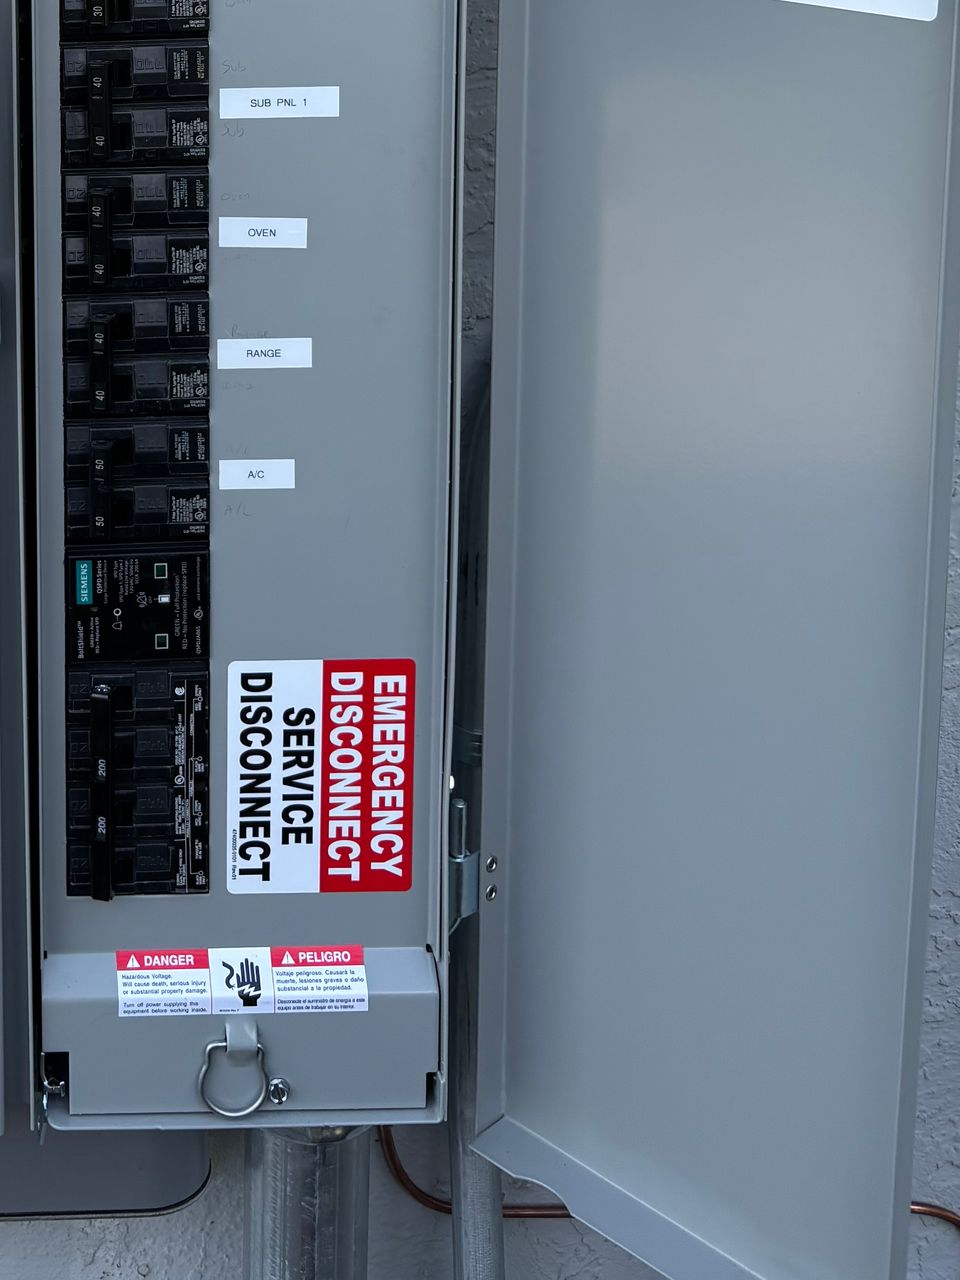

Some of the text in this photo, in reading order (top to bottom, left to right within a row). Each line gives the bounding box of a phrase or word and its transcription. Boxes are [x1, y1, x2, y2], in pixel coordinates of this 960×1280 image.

[94, 6, 102, 17] 30
[93, 77, 102, 88] 40
[250, 98, 271, 108] SUB
[277, 98, 296, 107] PNL
[96, 136, 104, 147] 40
[93, 206, 101, 217] 40
[248, 228, 276, 237] OVEN
[95, 264, 104, 275] 40
[95, 333, 104, 344] 40
[246, 349, 281, 359] RANGE
[96, 391, 105, 402] 40
[96, 459, 103, 471] 50
[248, 470, 264, 480] A/C
[96, 516, 104, 527] 50
[98, 759, 106, 776] 200
[239, 672, 272, 881] DISCONNECT
[281, 707, 315, 845] SERVICE
[328, 672, 363, 881] DISCONNECT
[370, 675, 407, 877] EMERGENCY
[98, 816, 106, 834] 200
[144, 955, 194, 966] DANGER
[298, 951, 351, 963] PELIGRO
